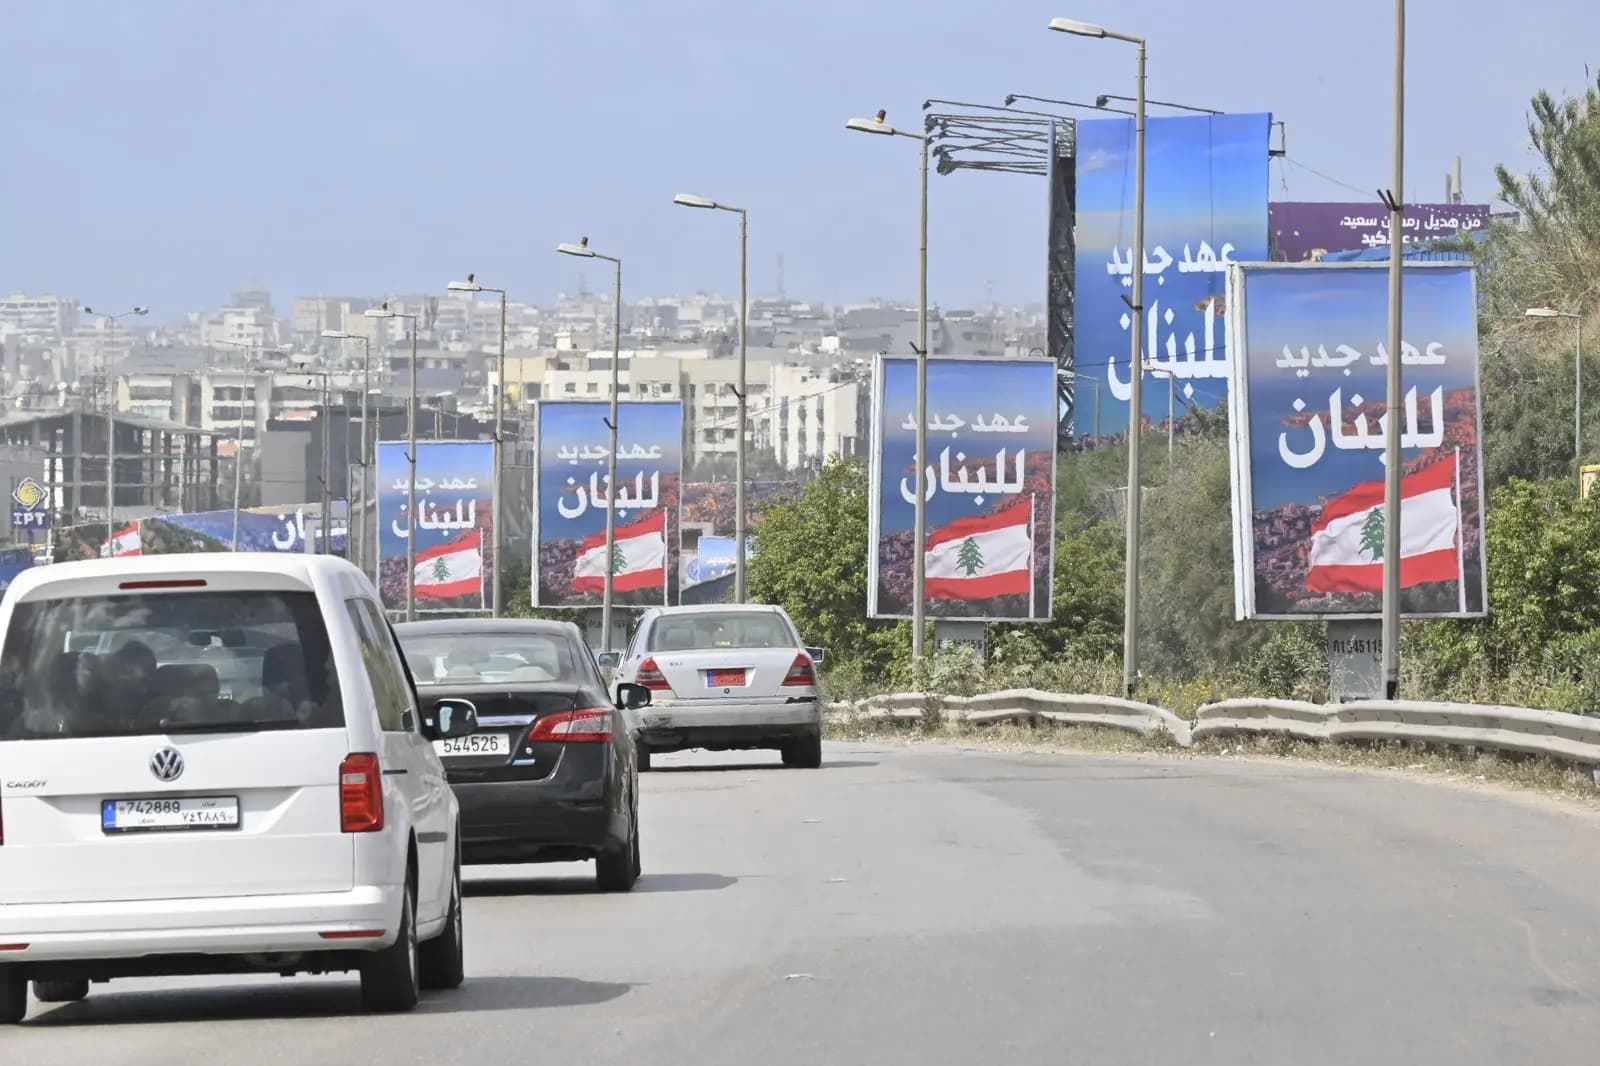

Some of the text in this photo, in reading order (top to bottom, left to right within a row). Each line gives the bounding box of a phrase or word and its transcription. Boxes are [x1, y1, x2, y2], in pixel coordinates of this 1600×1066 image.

[1424, 214, 1459, 231] هديل
[1178, 240, 1236, 273] عهد
[1275, 343, 1362, 378] جديد
[902, 411, 1030, 439] عهد جدد
[556, 443, 663, 465] عهد جديد
[438, 477, 477, 490] عهد
[900, 445, 1026, 506] للبنان
[13, 511, 46, 526] IPT
[443, 735, 499, 753] 544526
[125, 800, 182, 815] 742889
